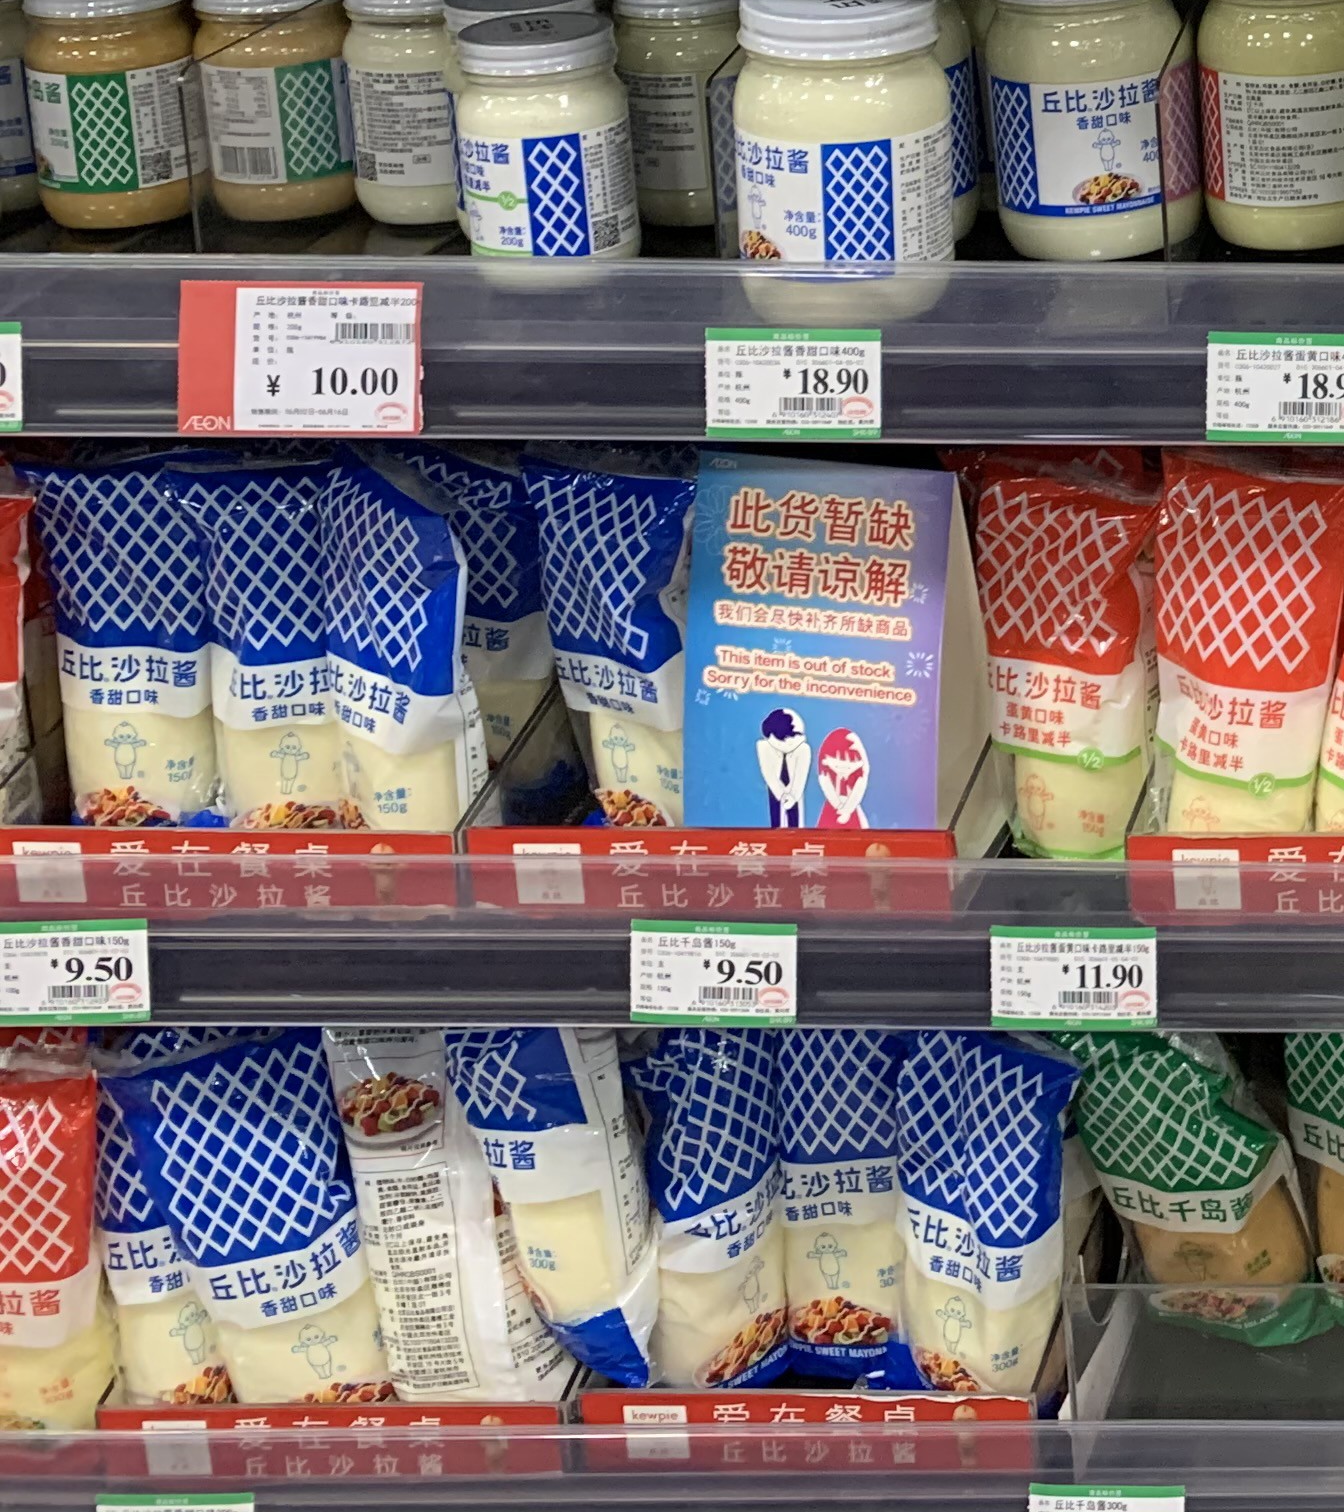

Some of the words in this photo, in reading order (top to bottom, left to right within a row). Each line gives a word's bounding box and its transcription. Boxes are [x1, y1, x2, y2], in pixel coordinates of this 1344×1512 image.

[1076, 112, 1132, 129] 香甜口味
[736, 344, 865, 358] 丘比沙拉酱香甜口味400g
[312, 367, 398, 396] 10.00
[798, 368, 869, 398] 18.90
[729, 488, 915, 552] 此货暂缺
[724, 544, 910, 606] 敬请谅解
[714, 602, 910, 638] 我们会尽快补齐所缺商品
[89, 688, 161, 706] 香甜口味
[658, 938, 736, 950] 丘比千岛酱150g
[65, 957, 133, 984] 9.50
[717, 960, 783, 986] 9.50
[1077, 964, 1143, 989] 11.90
[631, 1410, 679, 1425] kewpie
